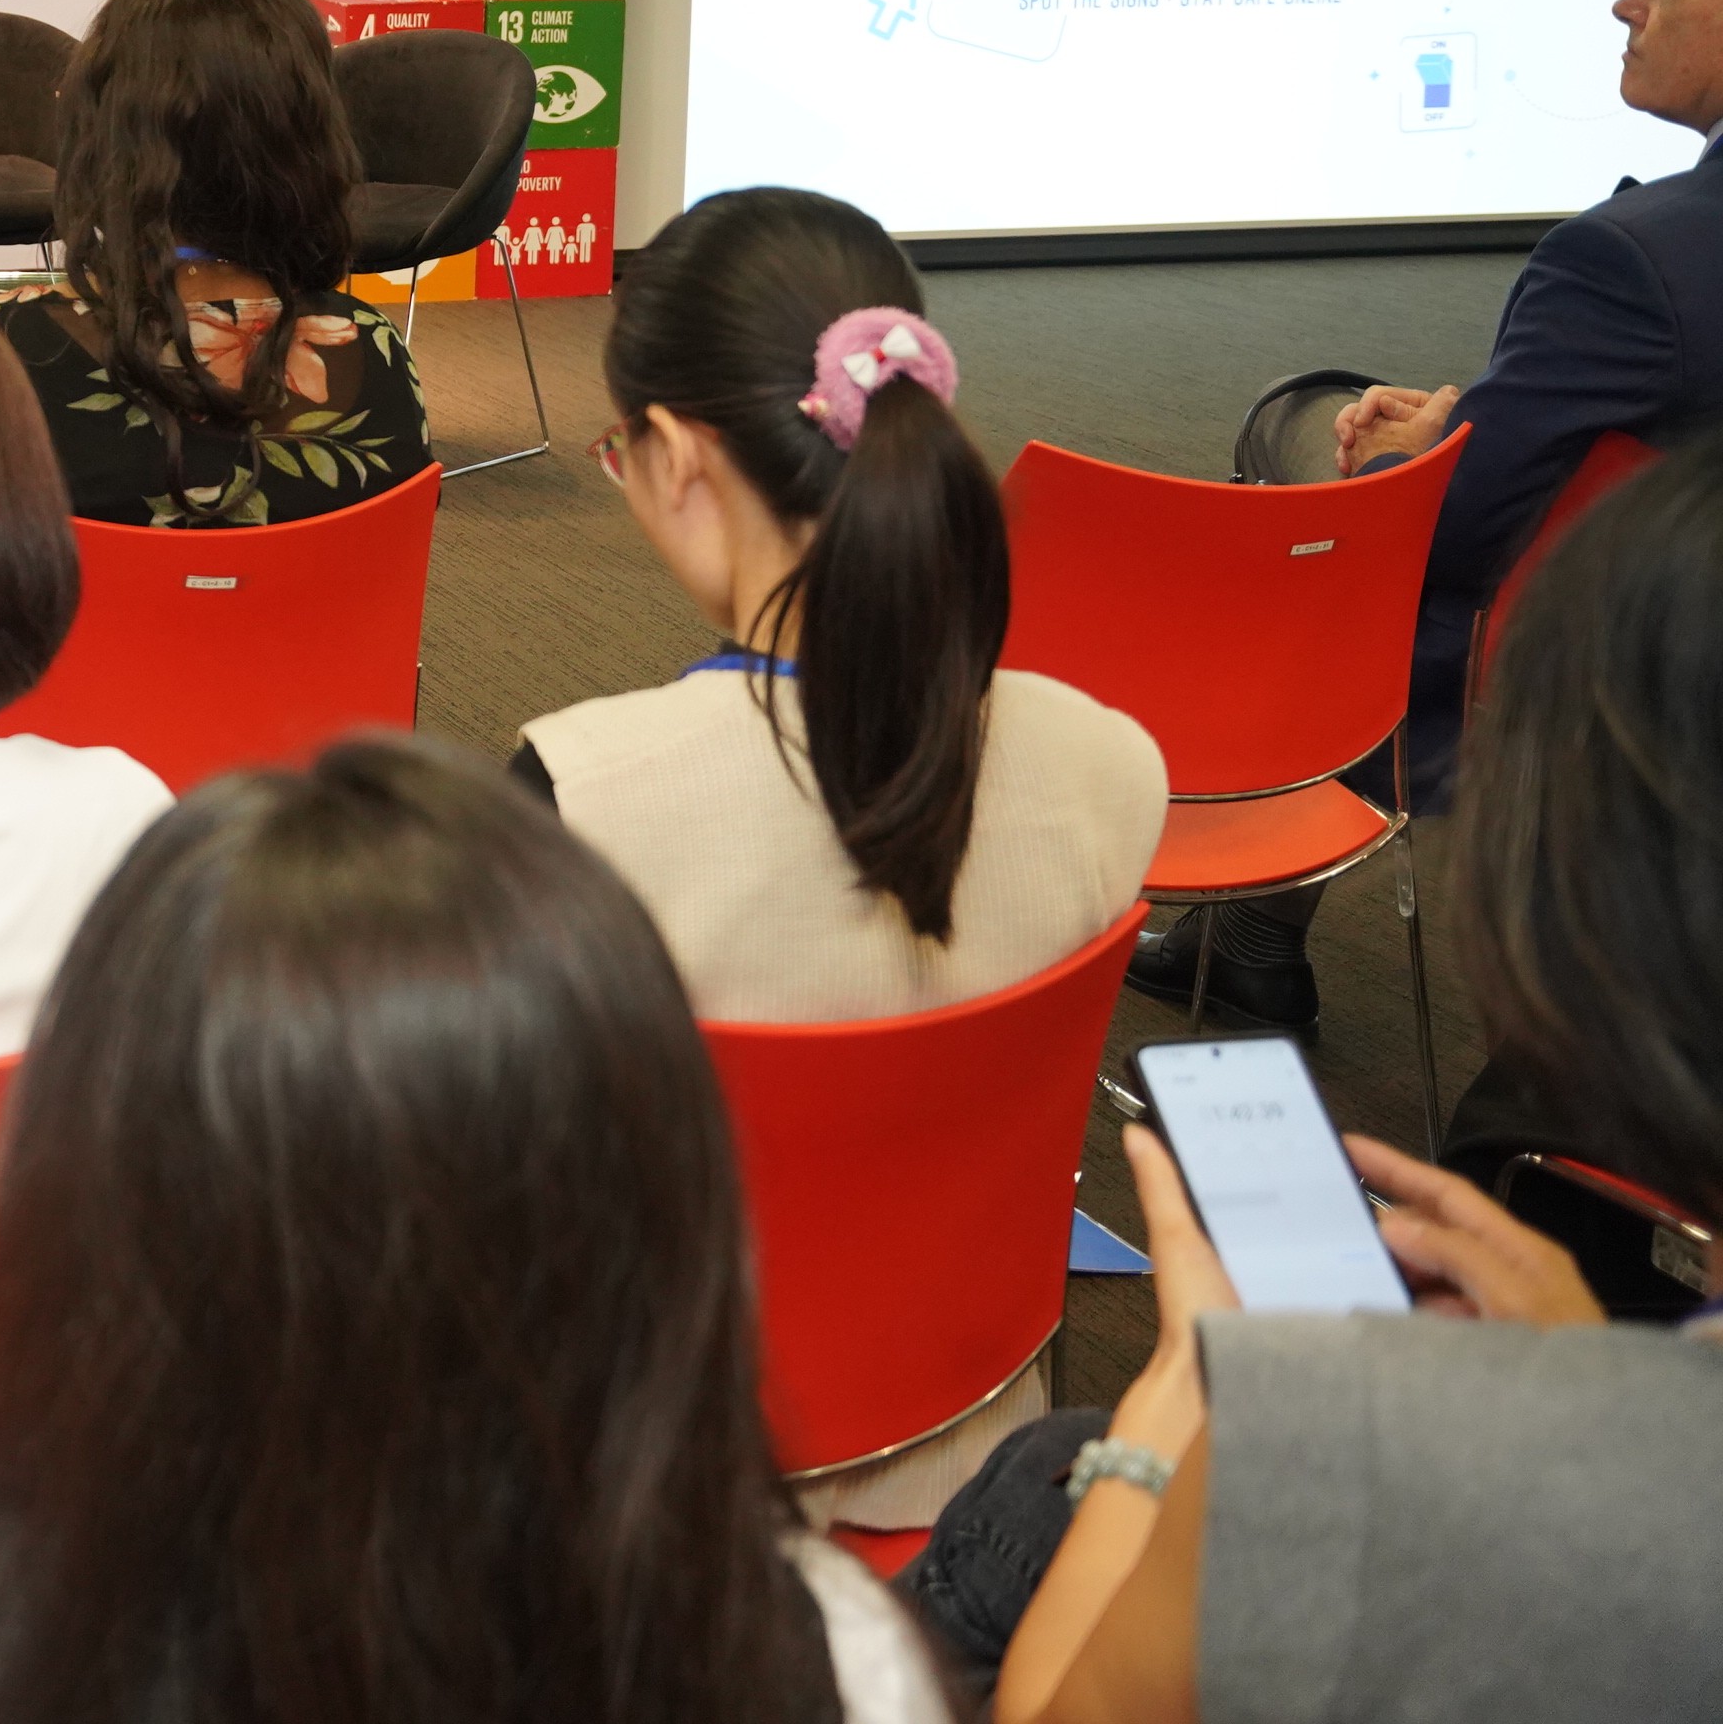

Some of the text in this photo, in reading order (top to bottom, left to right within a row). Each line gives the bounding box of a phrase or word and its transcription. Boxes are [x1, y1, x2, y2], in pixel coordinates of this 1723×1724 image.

[387, 13, 430, 29] QUALITY
[531, 10, 573, 27] CLIMATE
[498, 11, 524, 44] 13
[531, 29, 568, 44] ACTION
